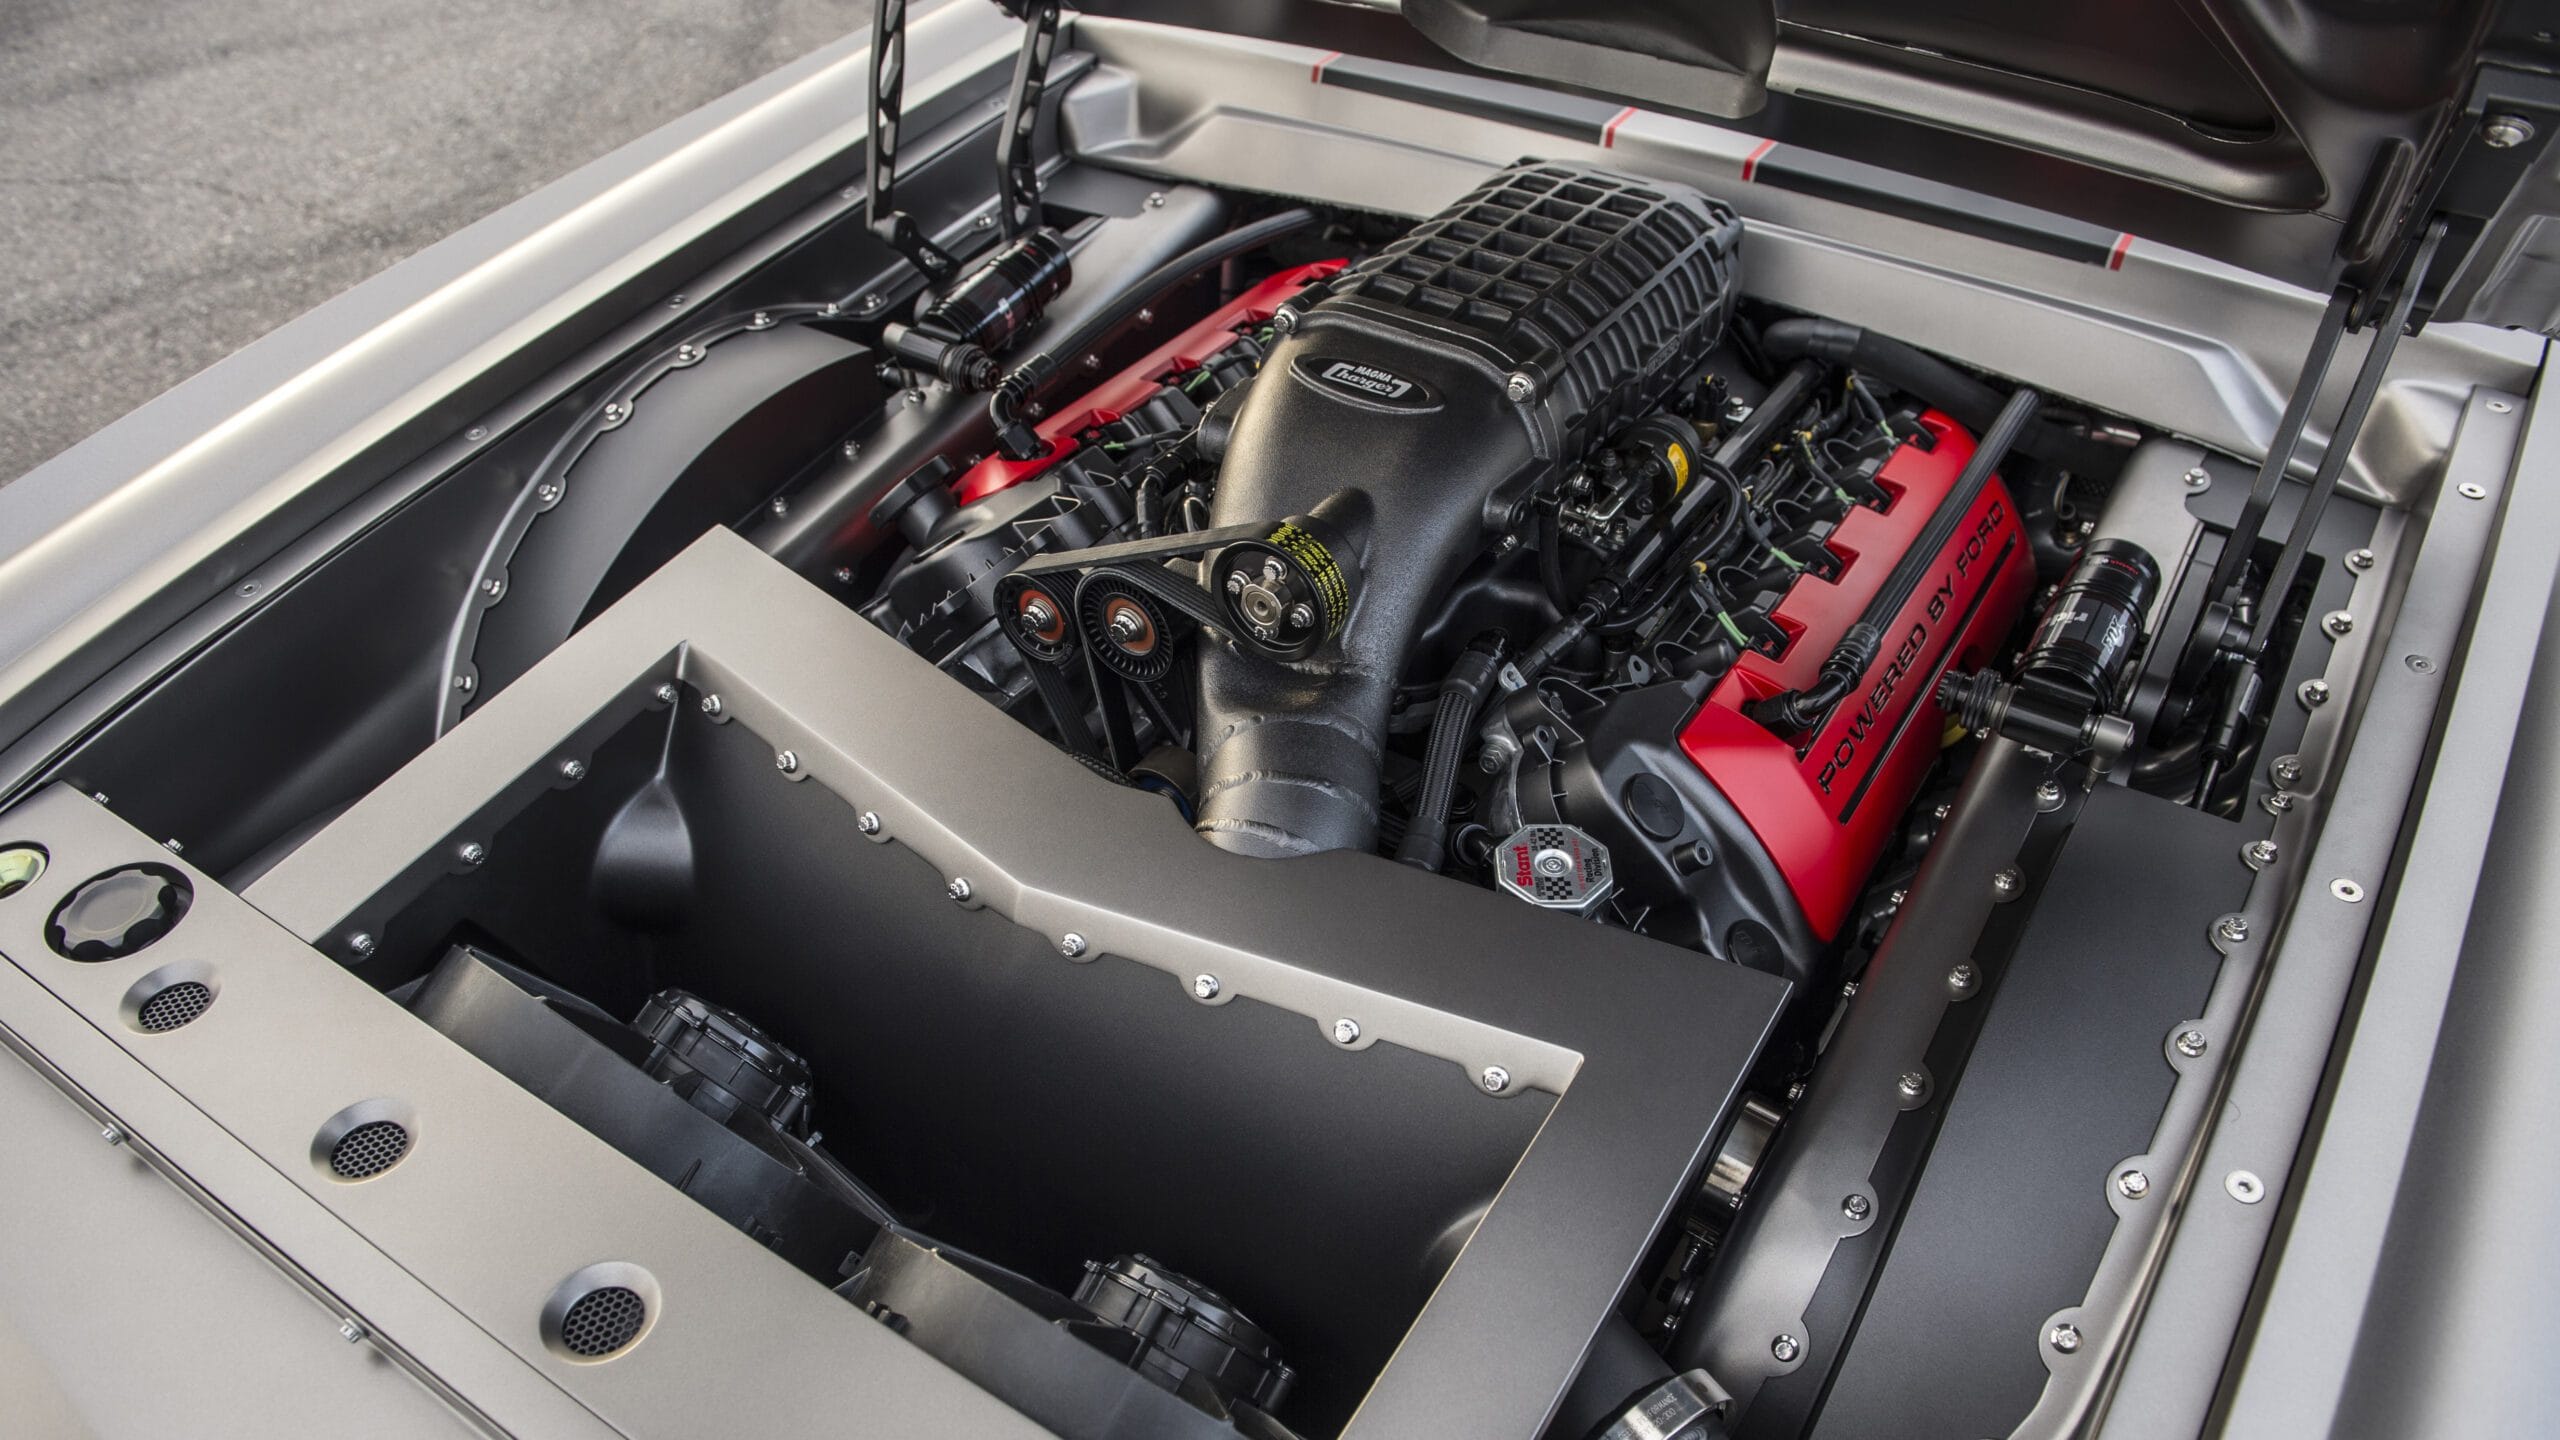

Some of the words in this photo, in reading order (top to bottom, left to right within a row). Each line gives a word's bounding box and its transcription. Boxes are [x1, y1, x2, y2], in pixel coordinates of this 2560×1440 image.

[1321, 362, 1412, 398] Charger
[1355, 365, 1393, 383] MAGNA
[1817, 623, 1928, 794] POWERED
[1927, 575, 1957, 624] BY
[1956, 501, 2005, 578] FORD
[2101, 614, 2124, 653] FOX
[1513, 844, 1534, 887] Stant
[1584, 859, 1595, 883] Racing
[1593, 848, 1602, 877] Division
